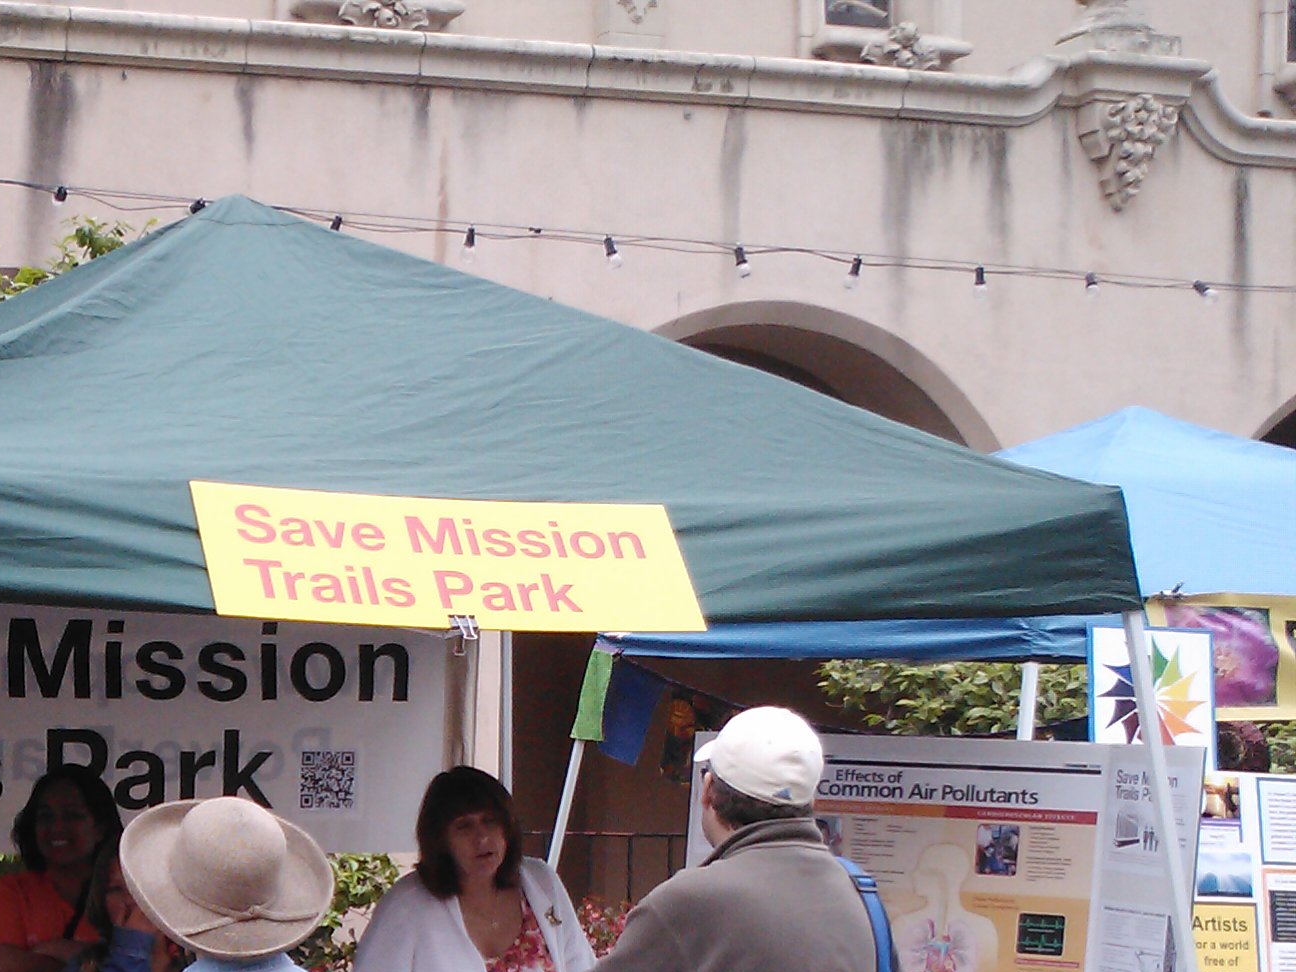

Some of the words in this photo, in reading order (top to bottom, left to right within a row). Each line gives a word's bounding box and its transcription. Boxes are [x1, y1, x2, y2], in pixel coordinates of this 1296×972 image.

[234, 504, 386, 551] Save
[404, 516, 646, 559] Mission
[243, 558, 416, 607] Trails
[433, 570, 584, 613] Park
[8, 618, 409, 702] Mission
[835, 769, 884, 784] Effects
[887, 771, 903, 783] of
[1116, 769, 1139, 785] Save
[816, 780, 904, 798] Common
[908, 783, 939, 801] Air
[941, 784, 1039, 805] Pollutants
[1115, 785, 1139, 801] Trails
[1192, 915, 1248, 933] Artists
[1196, 941, 1208, 950] or
[1210, 941, 1216, 950] a
[1219, 940, 1249, 951] world
[1204, 956, 1225, 967] free
[1227, 956, 1239, 967] of
